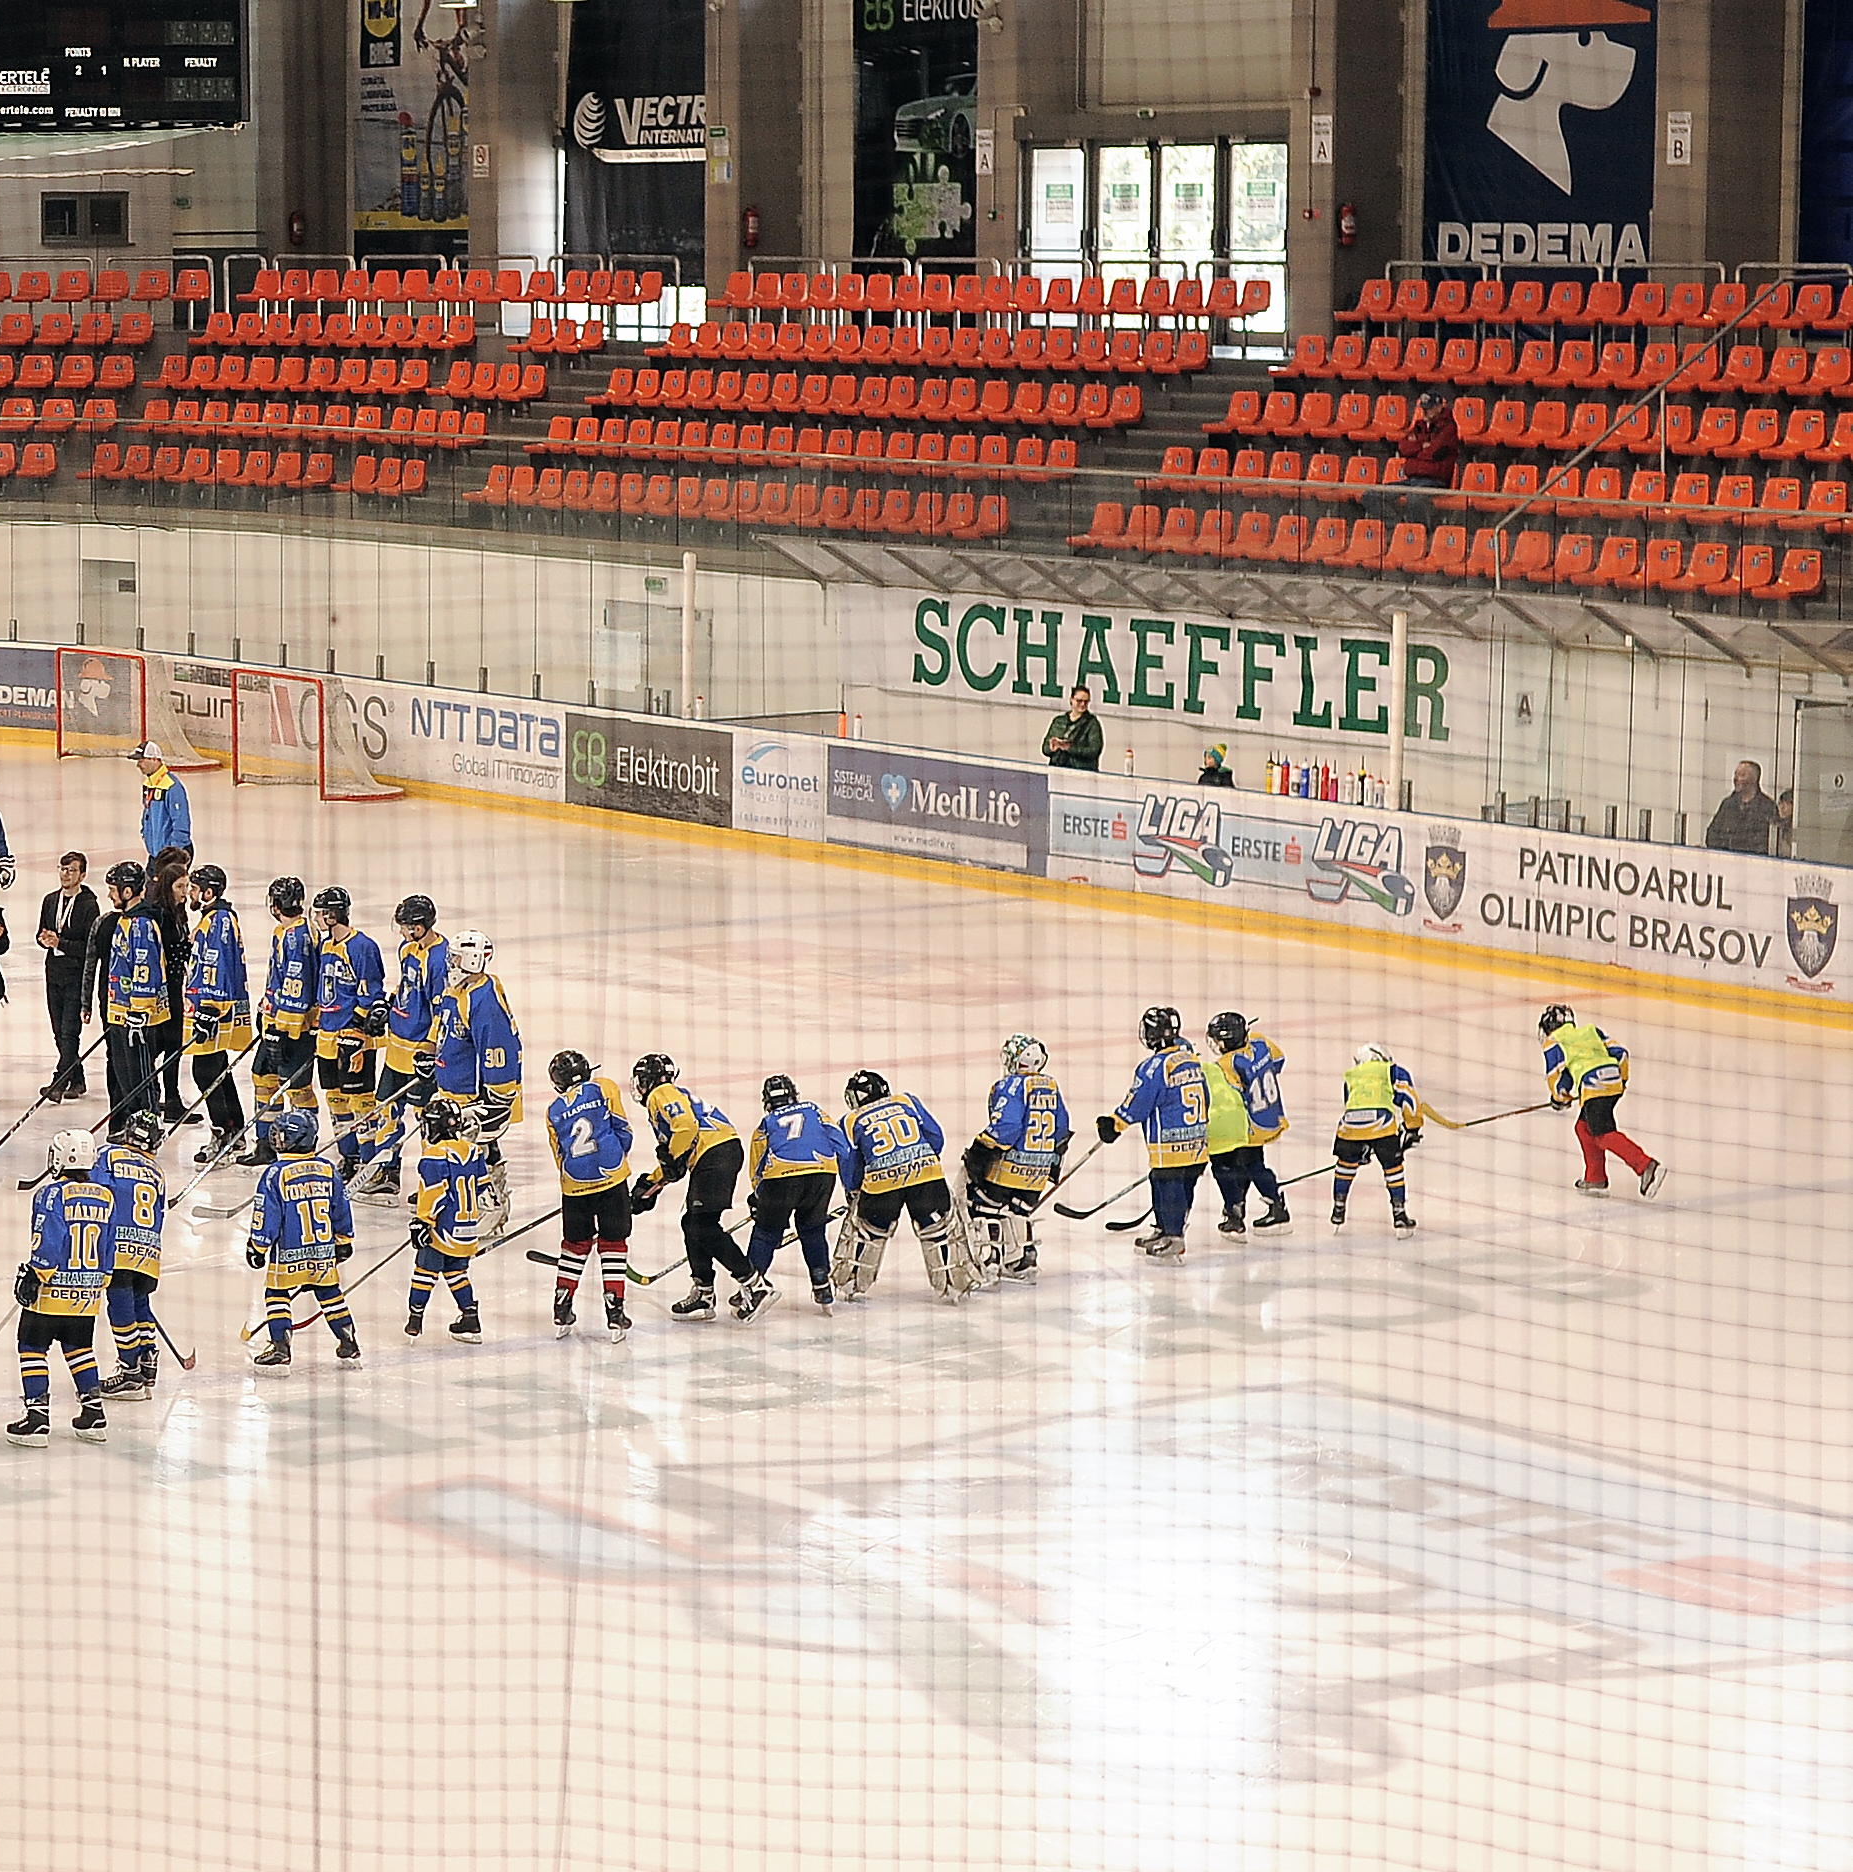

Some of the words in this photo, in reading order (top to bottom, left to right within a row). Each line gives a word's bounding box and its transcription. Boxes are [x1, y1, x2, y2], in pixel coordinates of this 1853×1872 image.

[75, 65, 82, 76] 2
[980, 153, 989, 169] A
[1317, 141, 1327, 159] A
[1674, 140, 1683, 158] B
[912, 597, 1450, 742] SCHAEFFLER
[1518, 695, 1531, 718] A
[452, 752, 488, 777] Global
[492, 759, 503, 778] IT
[506, 762, 560, 789] Innovator
[616, 745, 721, 797] Elektrobit
[741, 764, 819, 793] euronet
[833, 769, 873, 788] SISTEMUL
[833, 784, 874, 803] MEDICAL
[910, 778, 1021, 828] MedLife
[1063, 812, 1109, 839] ERSTE
[1137, 794, 1221, 847] LIGA
[1231, 835, 1281, 862] ERSTE
[1312, 818, 1403, 871] LIGA
[1518, 846, 1733, 912] PATINOARUL
[1480, 892, 1617, 944] OLIMPIC
[484, 1047, 506, 1068] 30
[570, 1116, 599, 1158] 2
[777, 1112, 806, 1141] 7
[864, 1114, 921, 1157] 30
[1024, 1110, 1056, 1152] 22
[133, 1183, 157, 1228] 8
[454, 1175, 478, 1223] 11
[297, 1198, 333, 1246] 15
[68, 1222, 102, 1270] 10
